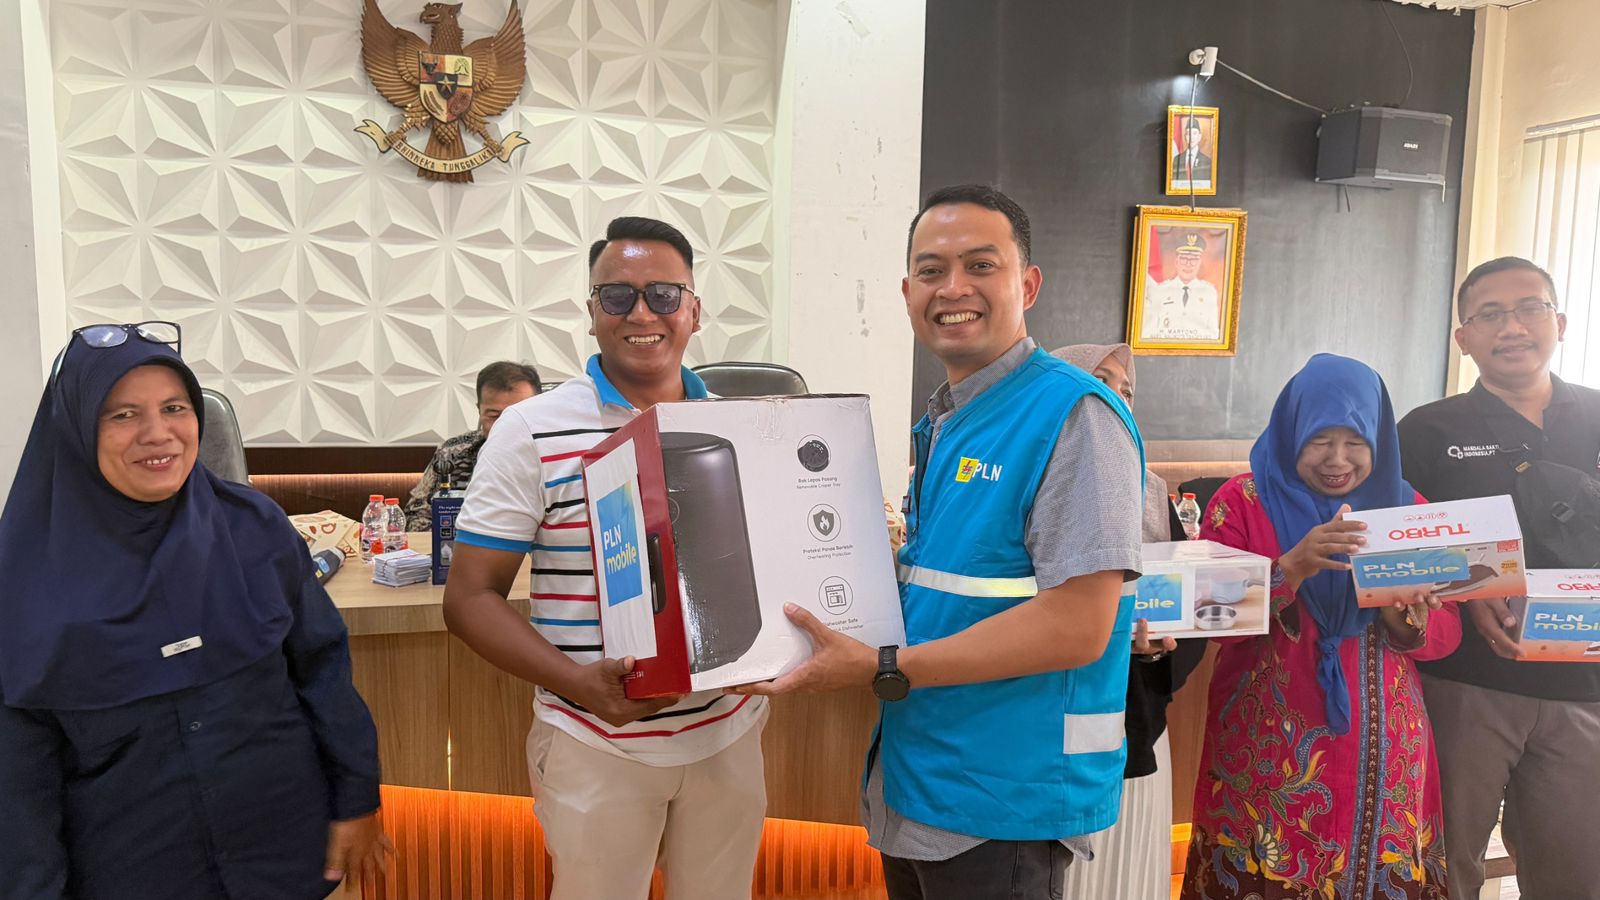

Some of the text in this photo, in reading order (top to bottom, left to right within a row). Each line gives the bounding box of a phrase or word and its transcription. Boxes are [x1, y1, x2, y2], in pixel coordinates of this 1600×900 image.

[972, 462, 1003, 482] PLN
[603, 524, 622, 551] PLN
[1388, 523, 1471, 540] TURBO
[606, 541, 637, 576] mobile
[1363, 561, 1415, 572] PLN
[1364, 565, 1460, 579] mobile
[1134, 598, 1175, 610] bile
[1535, 612, 1584, 623] PLN
[1534, 622, 1600, 632] mobi
